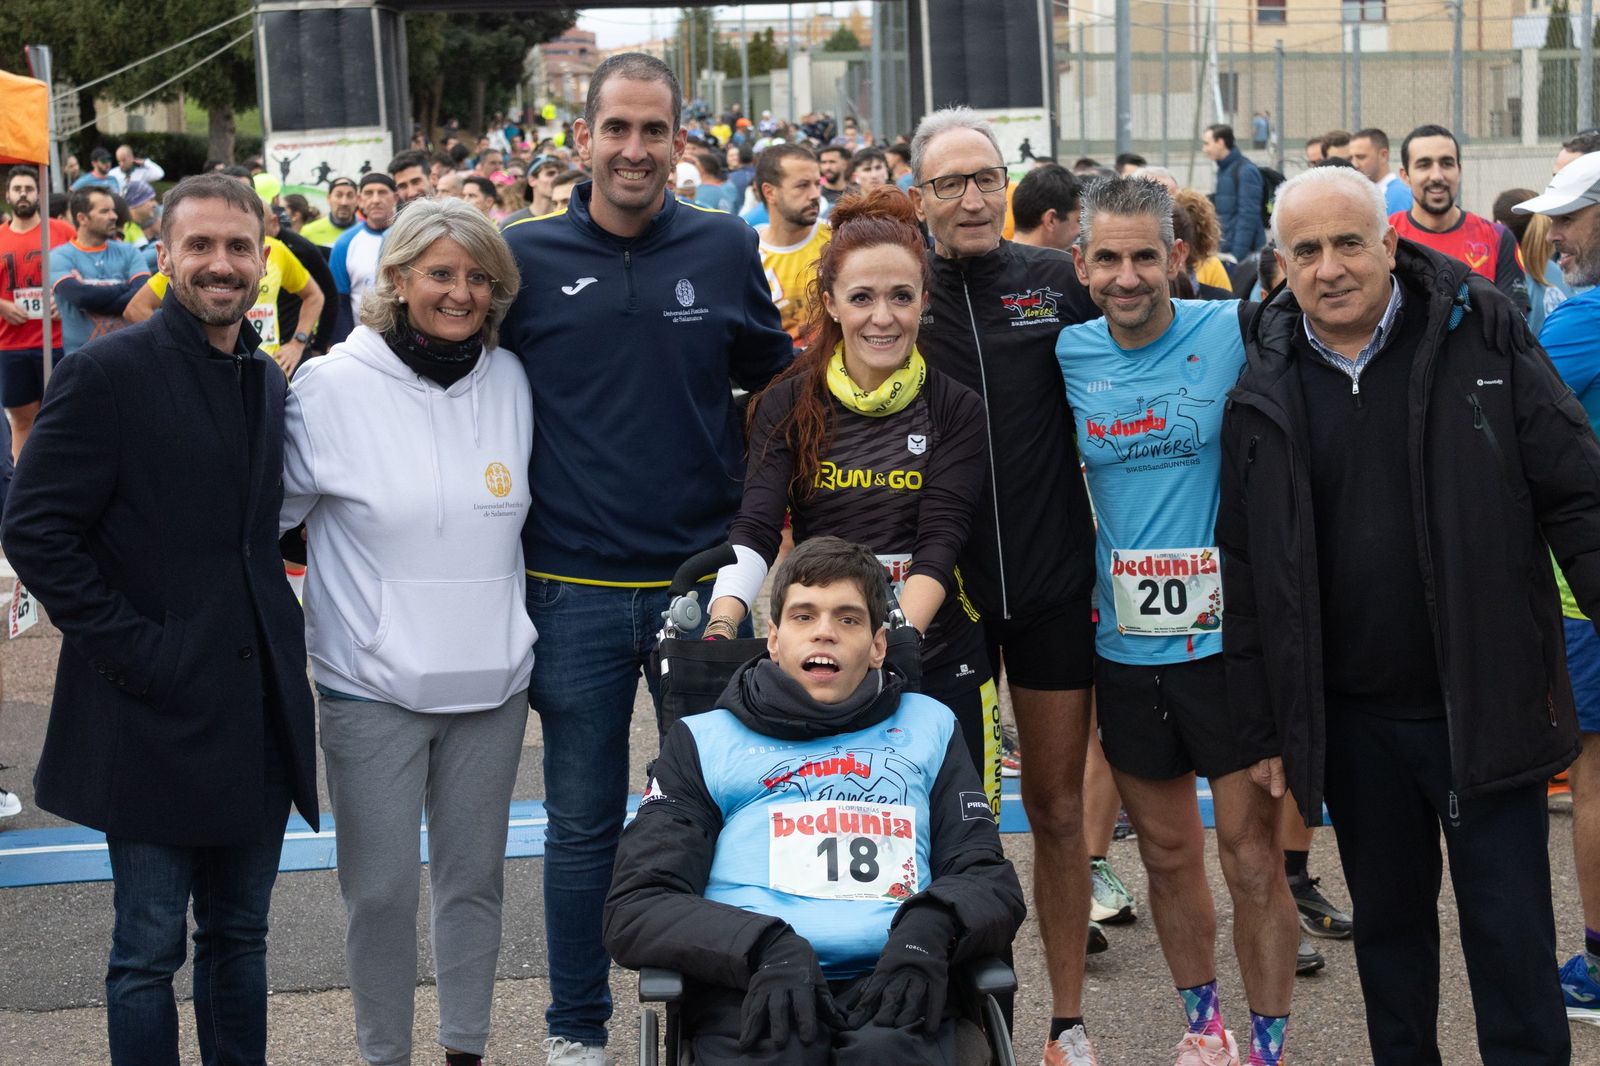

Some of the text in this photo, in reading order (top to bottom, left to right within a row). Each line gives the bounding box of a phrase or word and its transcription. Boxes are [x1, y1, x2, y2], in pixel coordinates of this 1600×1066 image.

[1126, 438, 1192, 460] FLOWERS
[814, 461, 923, 491] RUN & GO
[1126, 458, 1201, 474] BIKERSandRUNNERS
[1112, 555, 1218, 577] bedunia
[1138, 578, 1188, 616] 20
[773, 807, 913, 839] bedunia
[817, 836, 880, 883] 18
